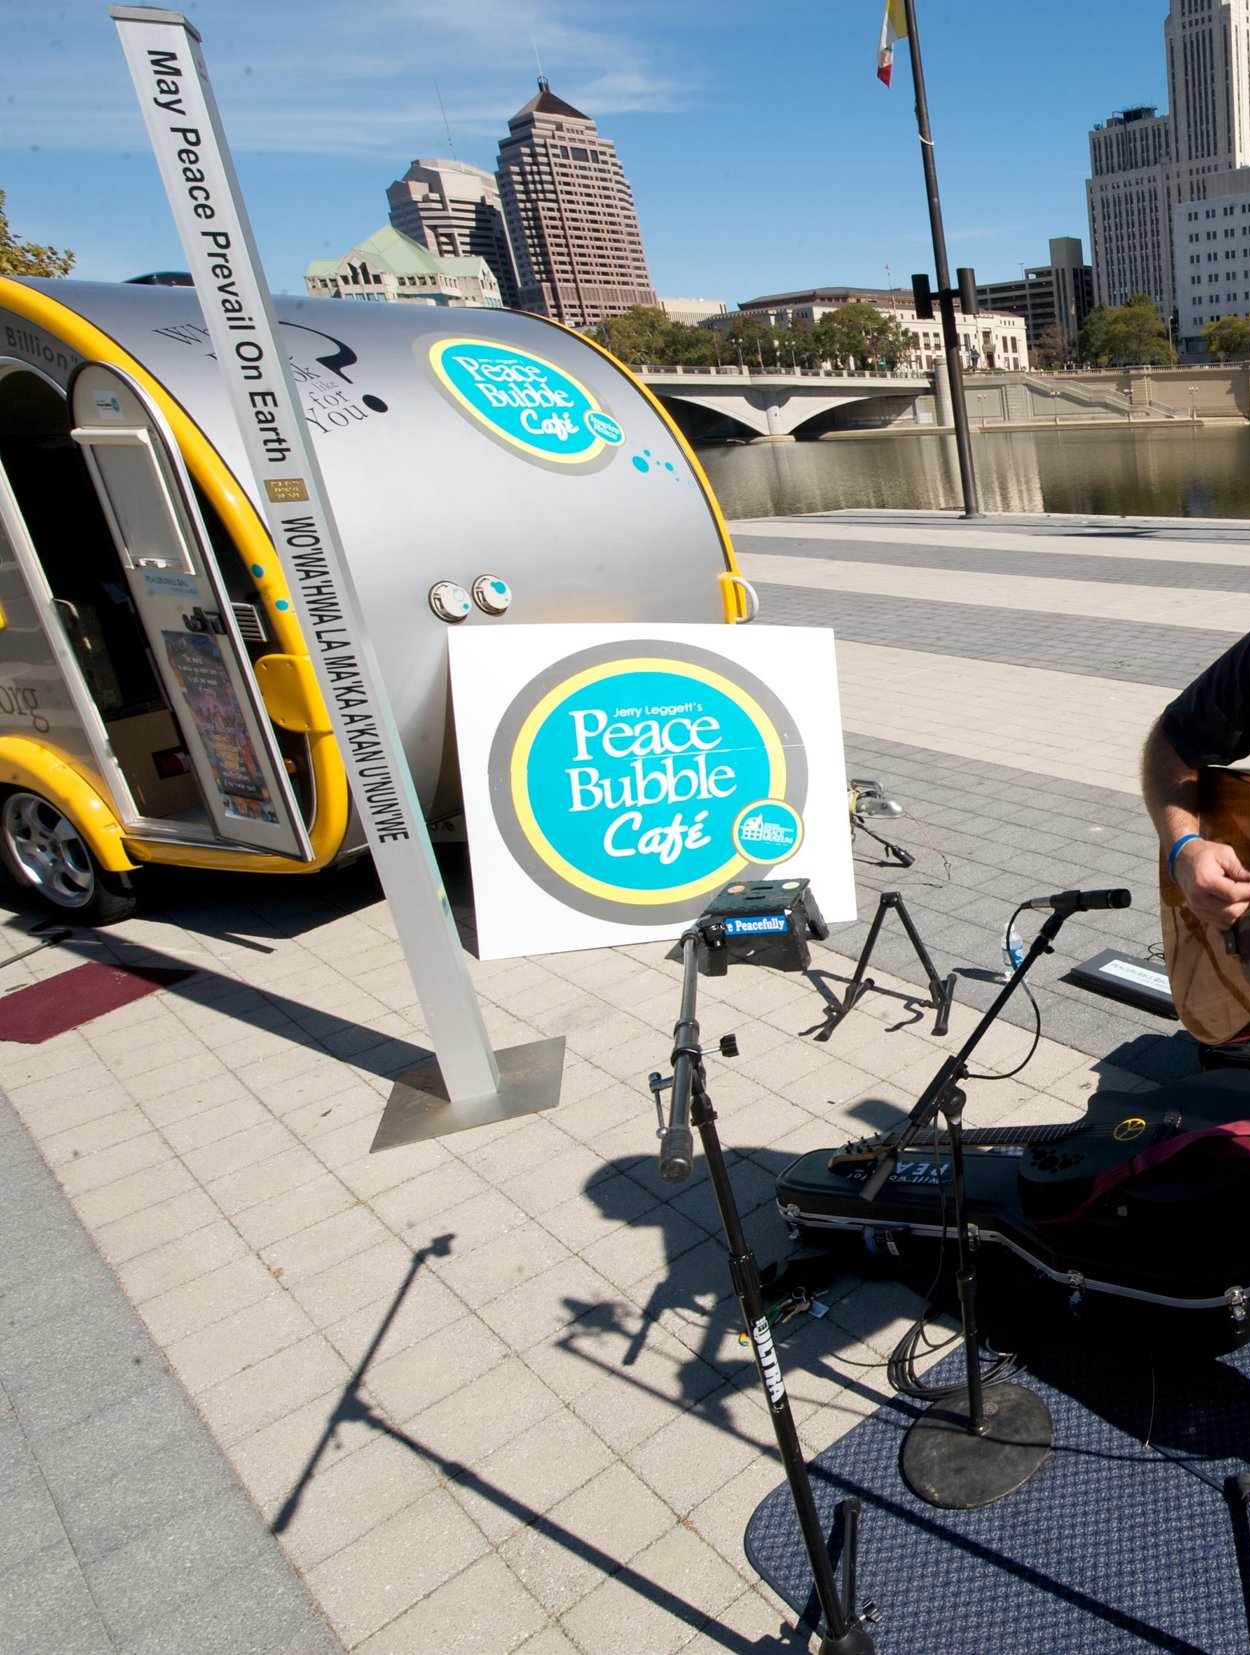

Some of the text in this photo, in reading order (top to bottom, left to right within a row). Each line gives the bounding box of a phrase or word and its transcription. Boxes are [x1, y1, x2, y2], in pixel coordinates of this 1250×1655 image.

[147, 49, 186, 116] May
[170, 127, 215, 219] Peace
[201, 231, 256, 332] Prevail
[235, 341, 264, 380] On
[452, 356, 548, 382] Peace
[309, 390, 350, 410] for
[474, 382, 574, 408] Bubble
[248, 391, 292, 463] Earth
[315, 628, 350, 653] LA
[613, 702, 703, 719] Jerry Leggett's
[568, 709, 723, 761] Peace
[564, 751, 737, 813] Bubble
[603, 810, 712, 865] Café
[734, 917, 785, 932] Peacefully
